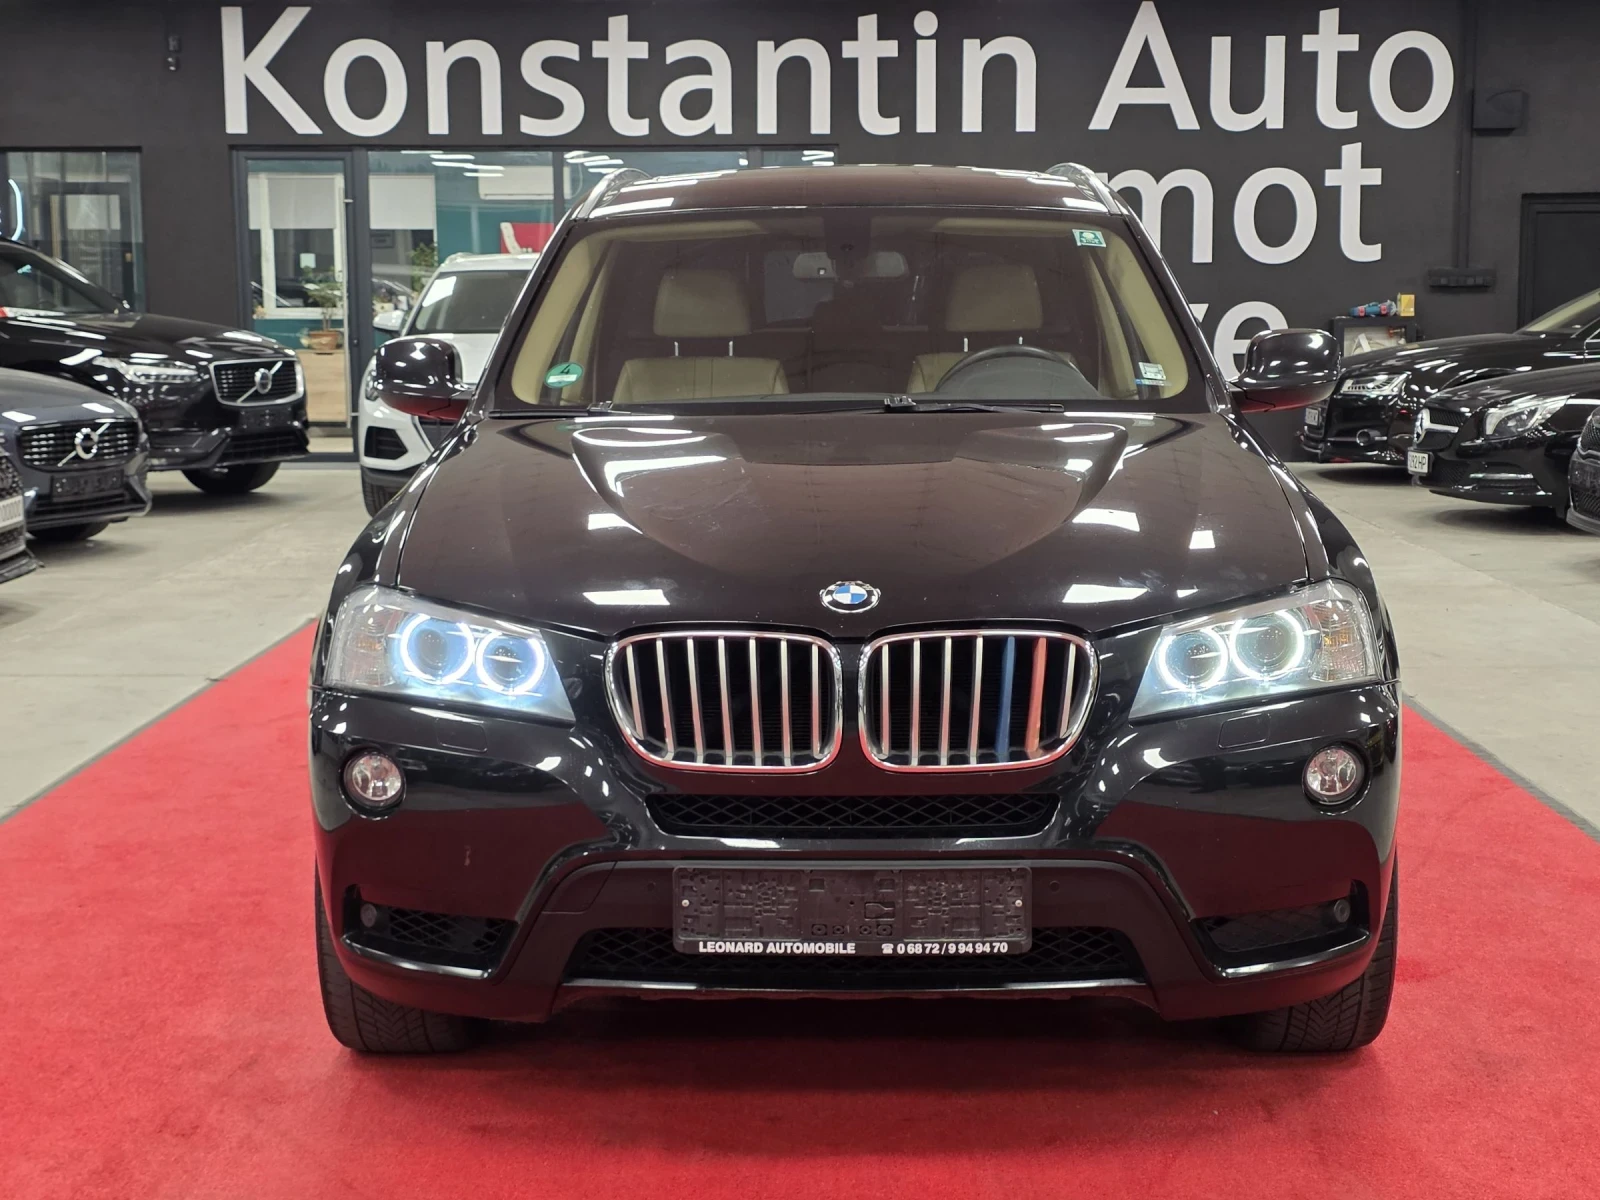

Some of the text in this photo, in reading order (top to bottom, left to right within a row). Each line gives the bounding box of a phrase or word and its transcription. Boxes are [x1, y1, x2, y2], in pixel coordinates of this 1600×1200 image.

[222, 1, 1454, 137] Konstantin Auto
[699, 941, 763, 953] LEONARD
[766, 942, 856, 954] AUTOMOBILE
